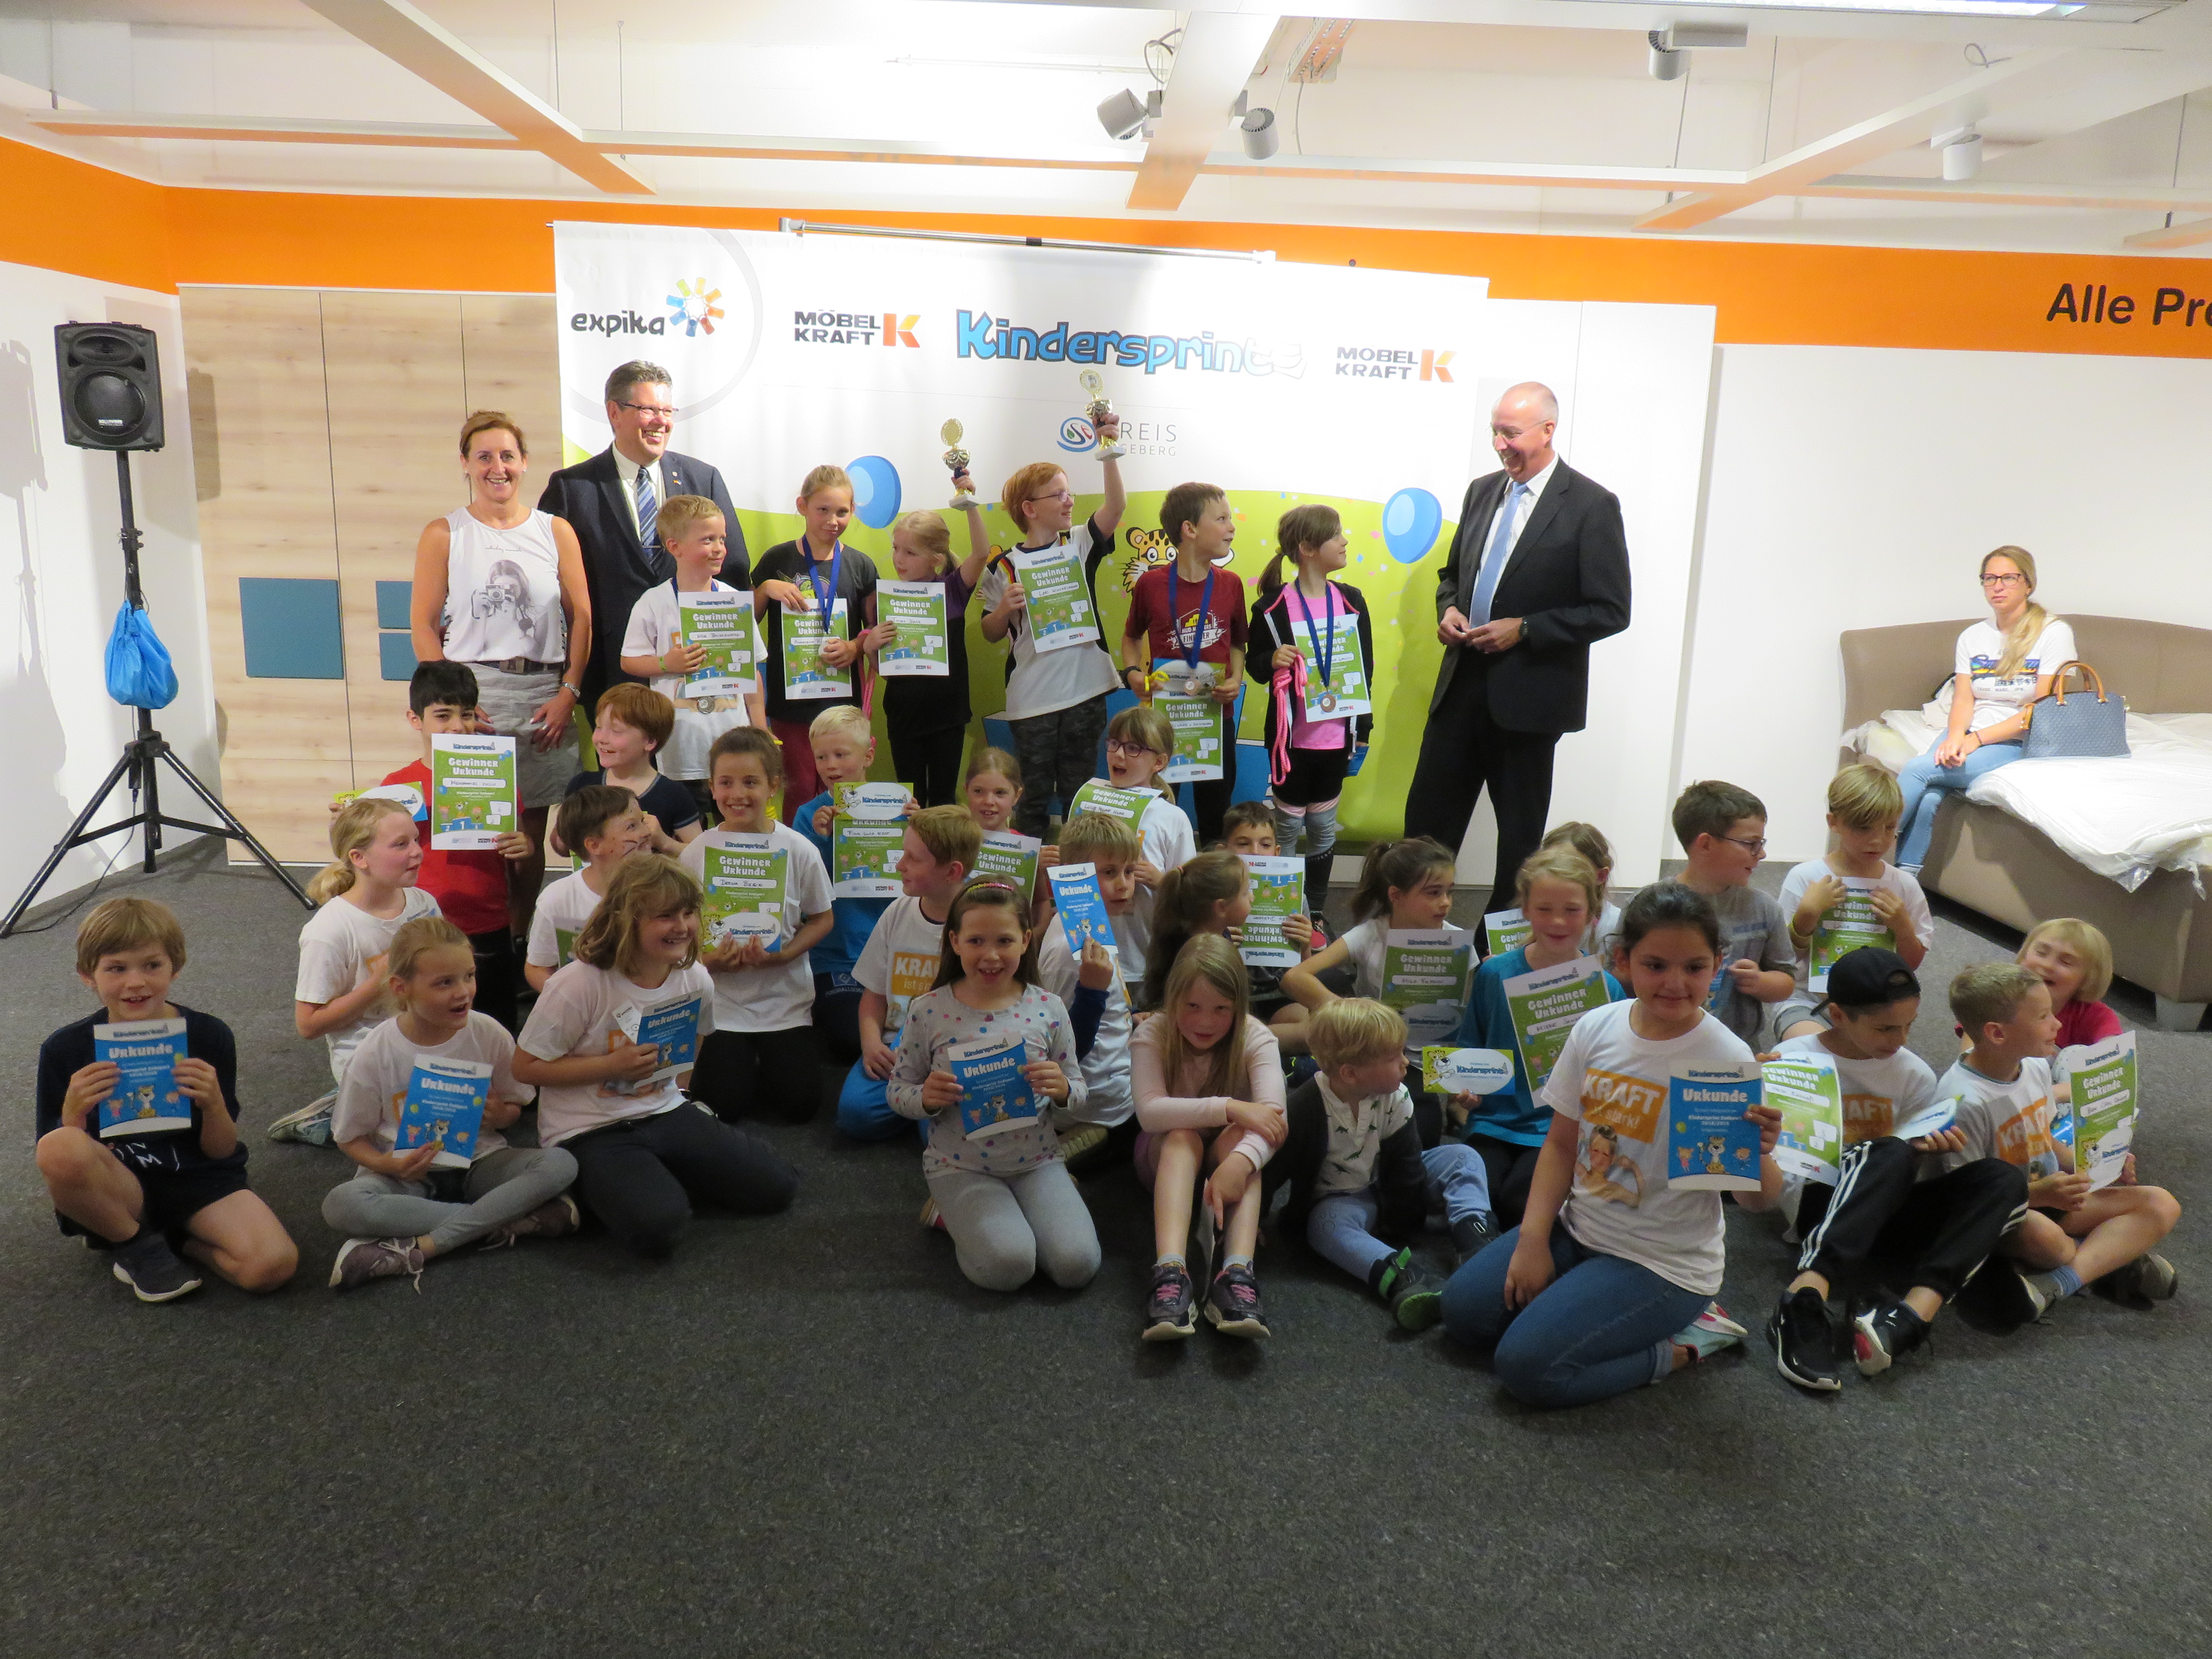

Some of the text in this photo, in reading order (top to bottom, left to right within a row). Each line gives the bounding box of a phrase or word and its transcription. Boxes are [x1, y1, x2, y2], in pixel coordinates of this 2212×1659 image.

[2046, 283, 2135, 324] Alle
[570, 309, 665, 338] expika
[794, 309, 881, 329] MÖBEL
[794, 328, 875, 345] KRAFT
[956, 308, 1275, 377] Kindersprint
[1336, 363, 1412, 380] KRAFT
[1121, 422, 1176, 442] REIS
[1031, 567, 1070, 580] Gewinner
[1036, 575, 1069, 587] Urkunde
[890, 599, 931, 608] Gewinner
[448, 757, 499, 767] Gewinner
[453, 767, 495, 776] Urkunde
[1092, 795, 1129, 806] Urkunde
[1093, 789, 1136, 801] Gewinner
[460, 821, 465, 830] 1
[719, 856, 771, 867] Gewinner
[978, 851, 1022, 865] Gewinner
[723, 866, 766, 876] Urkunde
[979, 861, 1016, 873] Urkunde
[859, 870, 863, 878] 1
[1278, 876, 1281, 884] 1
[1059, 884, 1093, 896] Urkunde
[1401, 954, 1452, 963] Gewinner
[1404, 964, 1447, 972] Urkunde
[904, 978, 916, 989] ist
[1528, 989, 1587, 1010] Gewinner
[1535, 1001, 1584, 1019] Urkunde
[648, 1010, 690, 1028] Urkunde
[109, 1043, 173, 1059] Urkunde
[963, 1057, 1016, 1077] Urkunde
[1456, 1065, 1505, 1074] Kindersprint
[1768, 1073, 1816, 1090] Urkunde
[2083, 1067, 2124, 1089] Gewinner
[422, 1078, 475, 1095] Urkunde
[2087, 1080, 2121, 1099] Urkunde
[1582, 1074, 1660, 1114] KRAFT
[1683, 1089, 1747, 1102] Urkunde
[1783, 1135, 1788, 1146] 1
